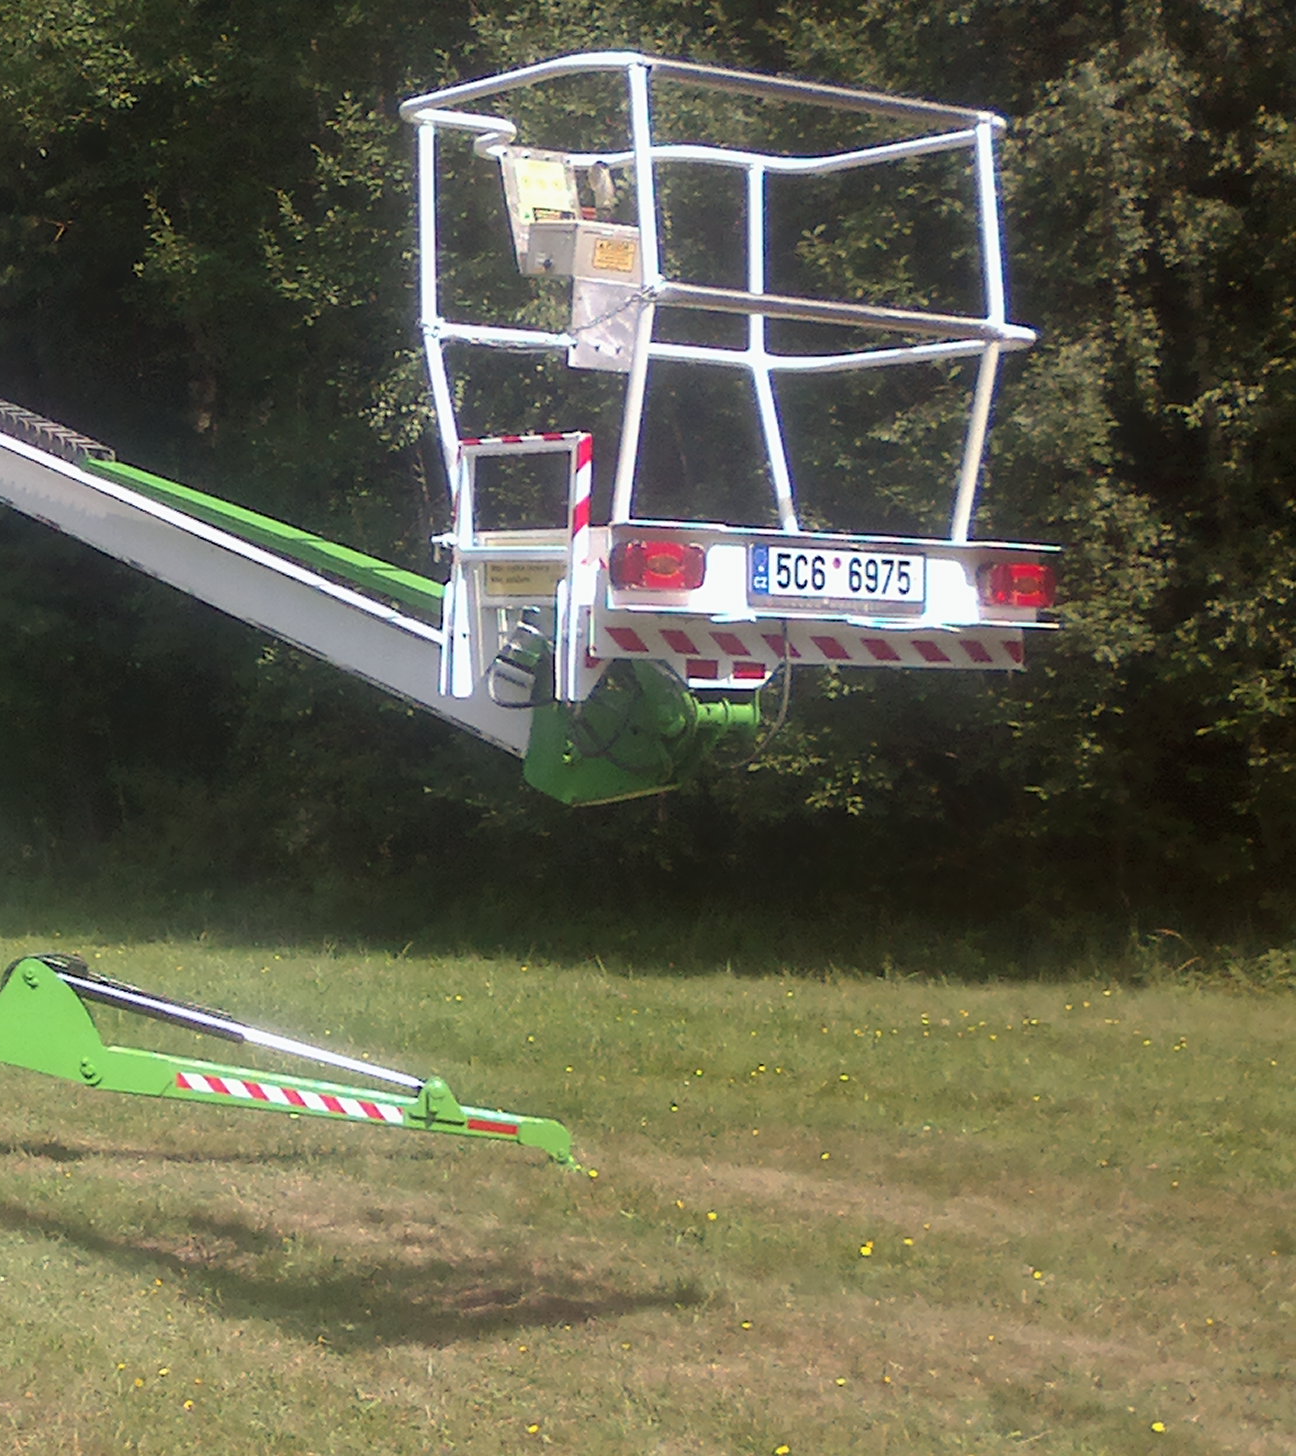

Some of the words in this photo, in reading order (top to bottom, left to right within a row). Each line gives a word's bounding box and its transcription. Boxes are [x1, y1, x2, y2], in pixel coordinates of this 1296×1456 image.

[754, 576, 768, 589] CZ
[776, 553, 826, 591] 5C6
[848, 557, 912, 595] 6975
